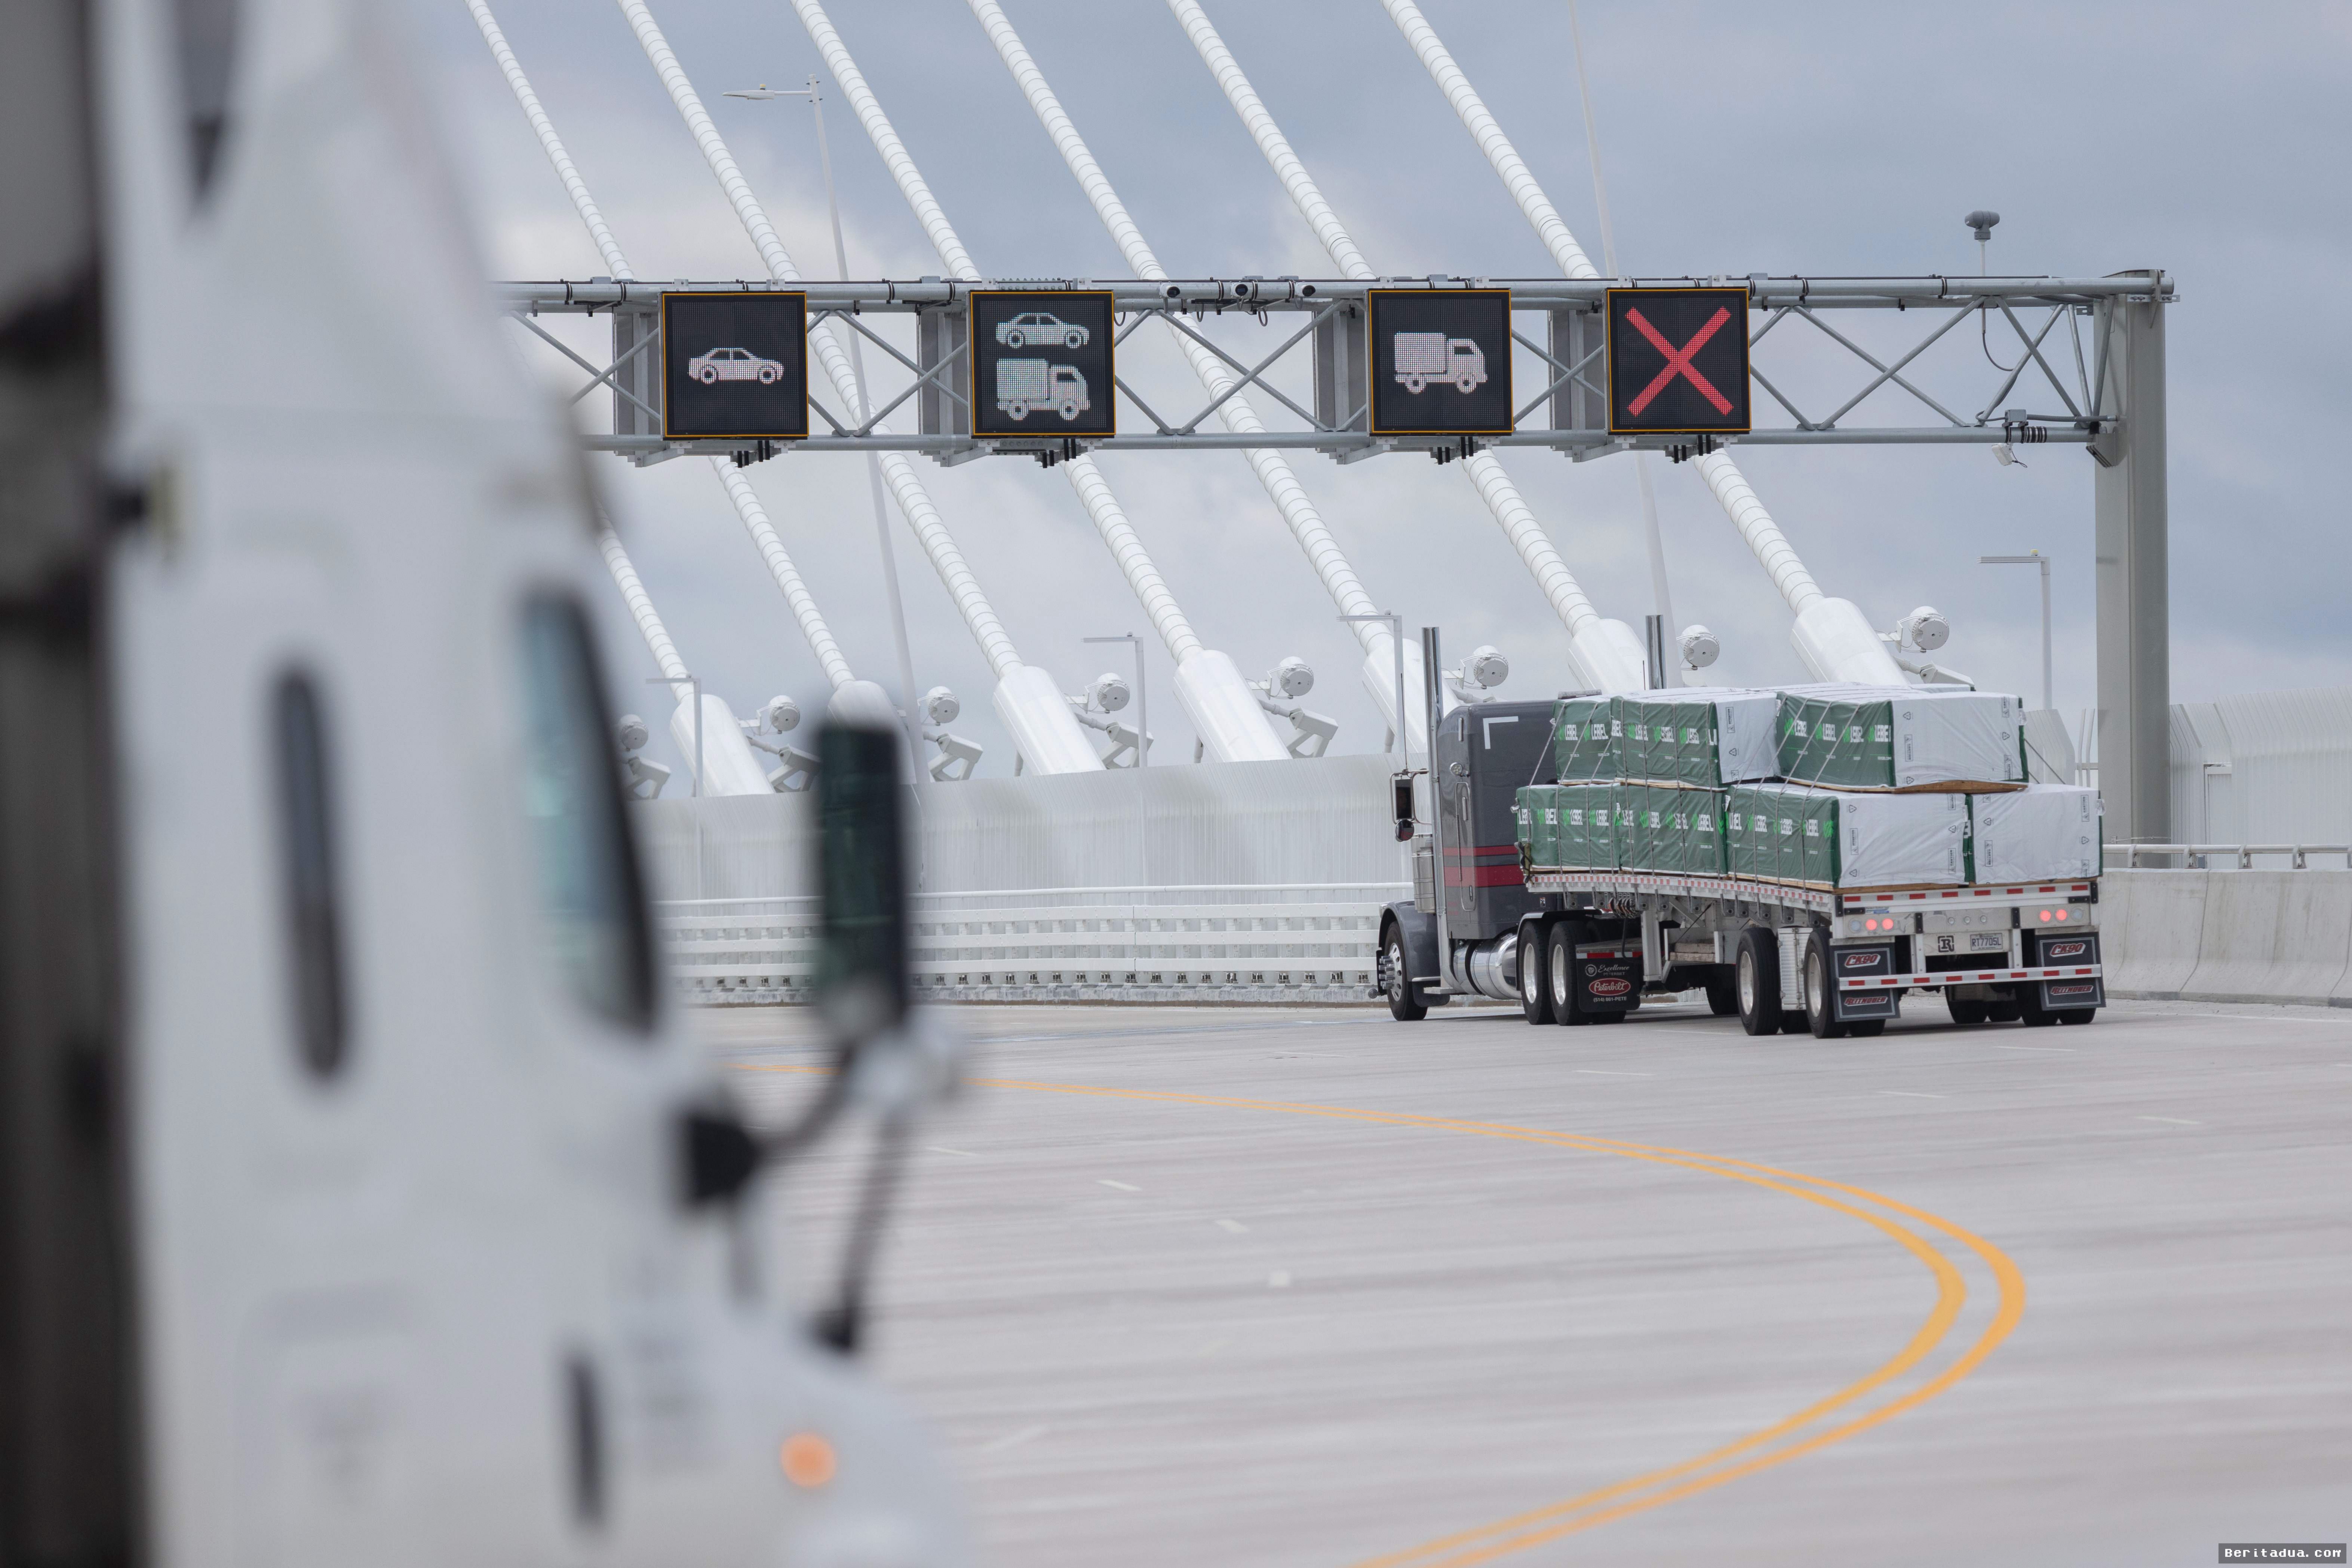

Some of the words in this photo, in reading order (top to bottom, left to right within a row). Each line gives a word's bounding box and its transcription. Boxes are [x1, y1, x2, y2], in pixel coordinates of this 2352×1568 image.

[1591, 724, 1609, 740] LEBEL
[1698, 814, 1714, 832] LEBEL
[1972, 937, 2001, 947] RT7705L
[2050, 943, 2085, 957] CK90
[1845, 954, 1880, 967] CK90
[1598, 964, 1630, 973] Excellence
[1594, 982, 1627, 992] Peterbilt
